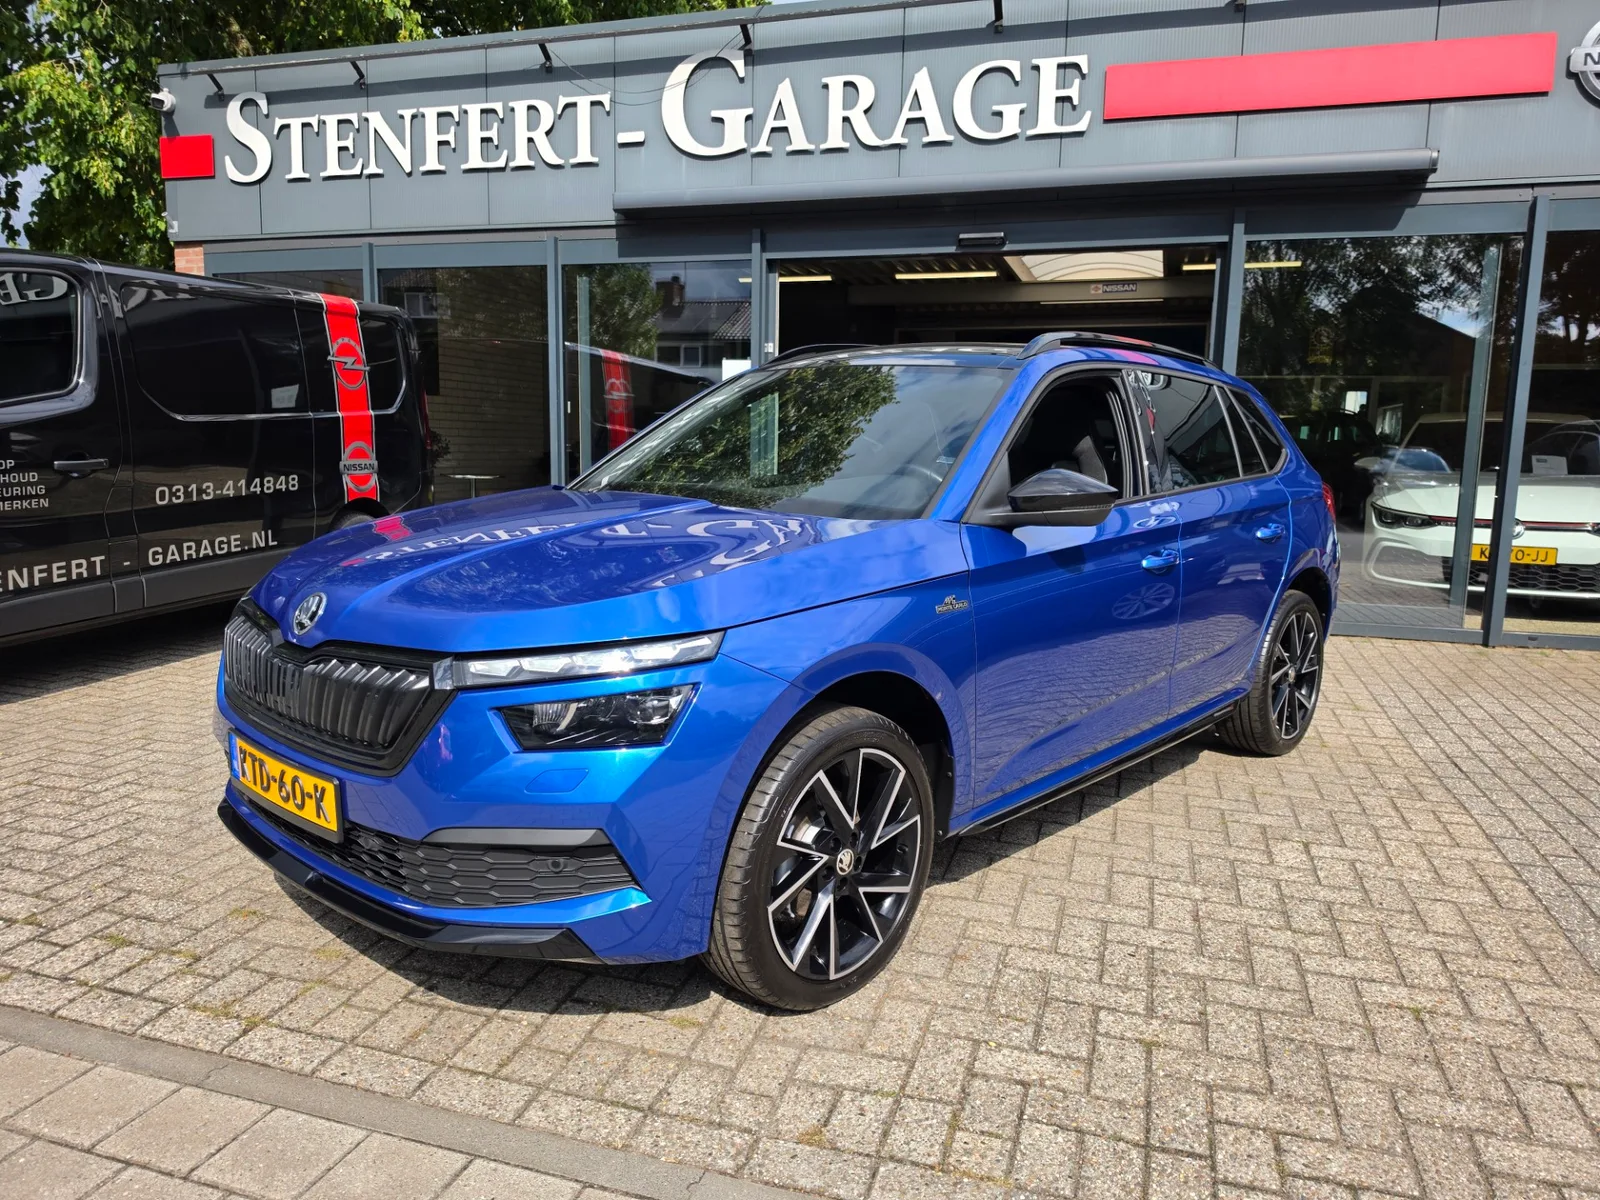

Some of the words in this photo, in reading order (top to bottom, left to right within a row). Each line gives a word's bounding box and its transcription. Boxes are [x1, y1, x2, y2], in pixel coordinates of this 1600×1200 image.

[1103, 284, 1136, 292] NISSAN
[343, 463, 375, 472] NISSAN
[0, 485, 46, 497] URING
[155, 474, 299, 505] 0313-414848
[0, 555, 105, 592] NFERT
[148, 529, 278, 566] GARAGE.NL
[239, 746, 331, 824] KTD-60-K
